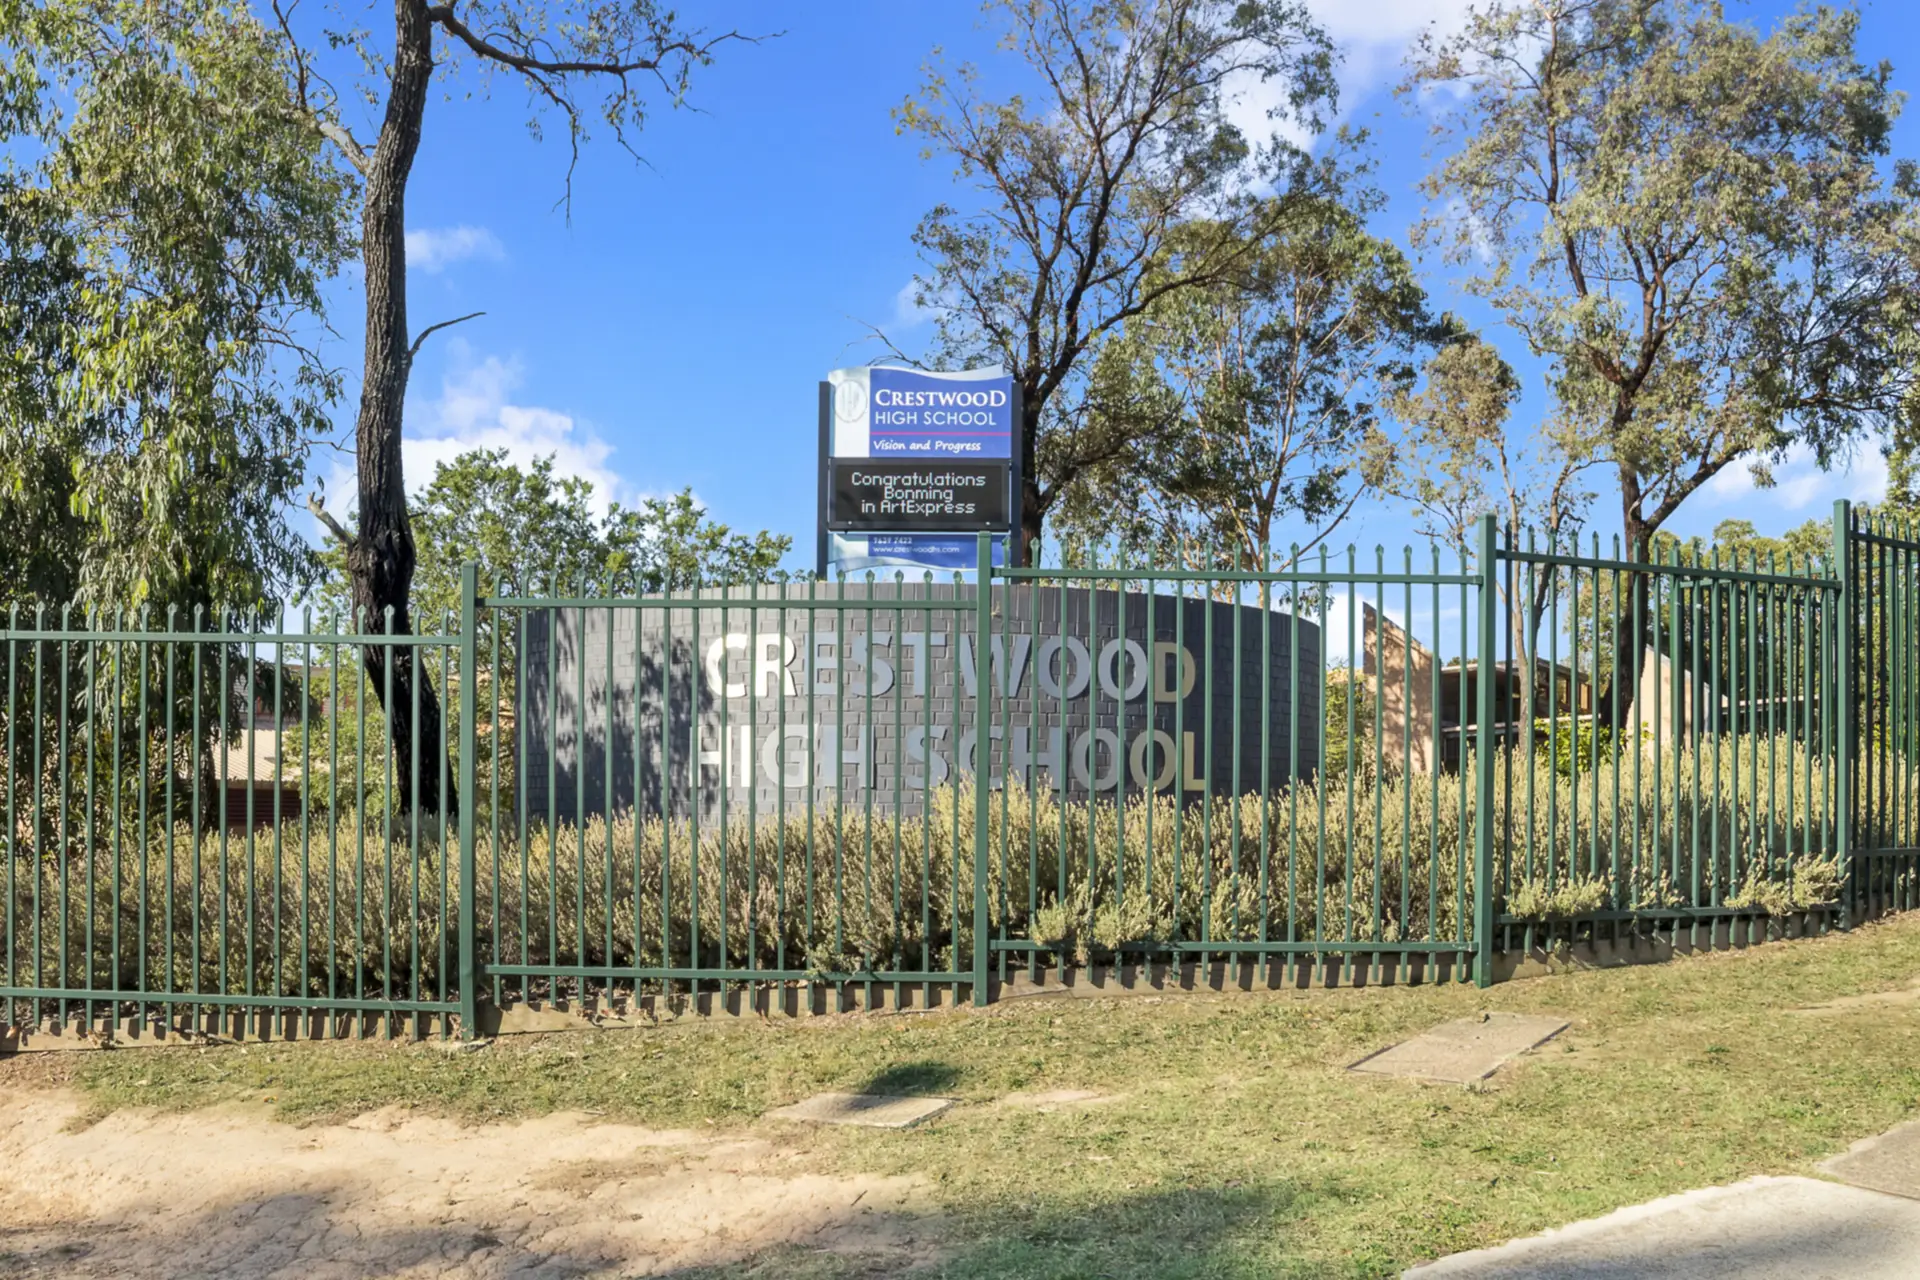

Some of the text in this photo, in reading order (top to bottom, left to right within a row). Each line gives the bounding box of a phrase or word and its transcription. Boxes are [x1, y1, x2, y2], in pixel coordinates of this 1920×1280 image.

[875, 389, 1006, 407] CRESTWOOD
[875, 411, 997, 426] HIGH SCHOOL
[873, 440, 981, 453] Vision and Progress
[851, 472, 986, 488] Congratulations
[884, 486, 953, 502] Bonming
[861, 500, 976, 516] in ArtExpress
[706, 632, 1196, 703] CRESTWOOD
[690, 724, 1206, 792] HIGH SCHOOL
